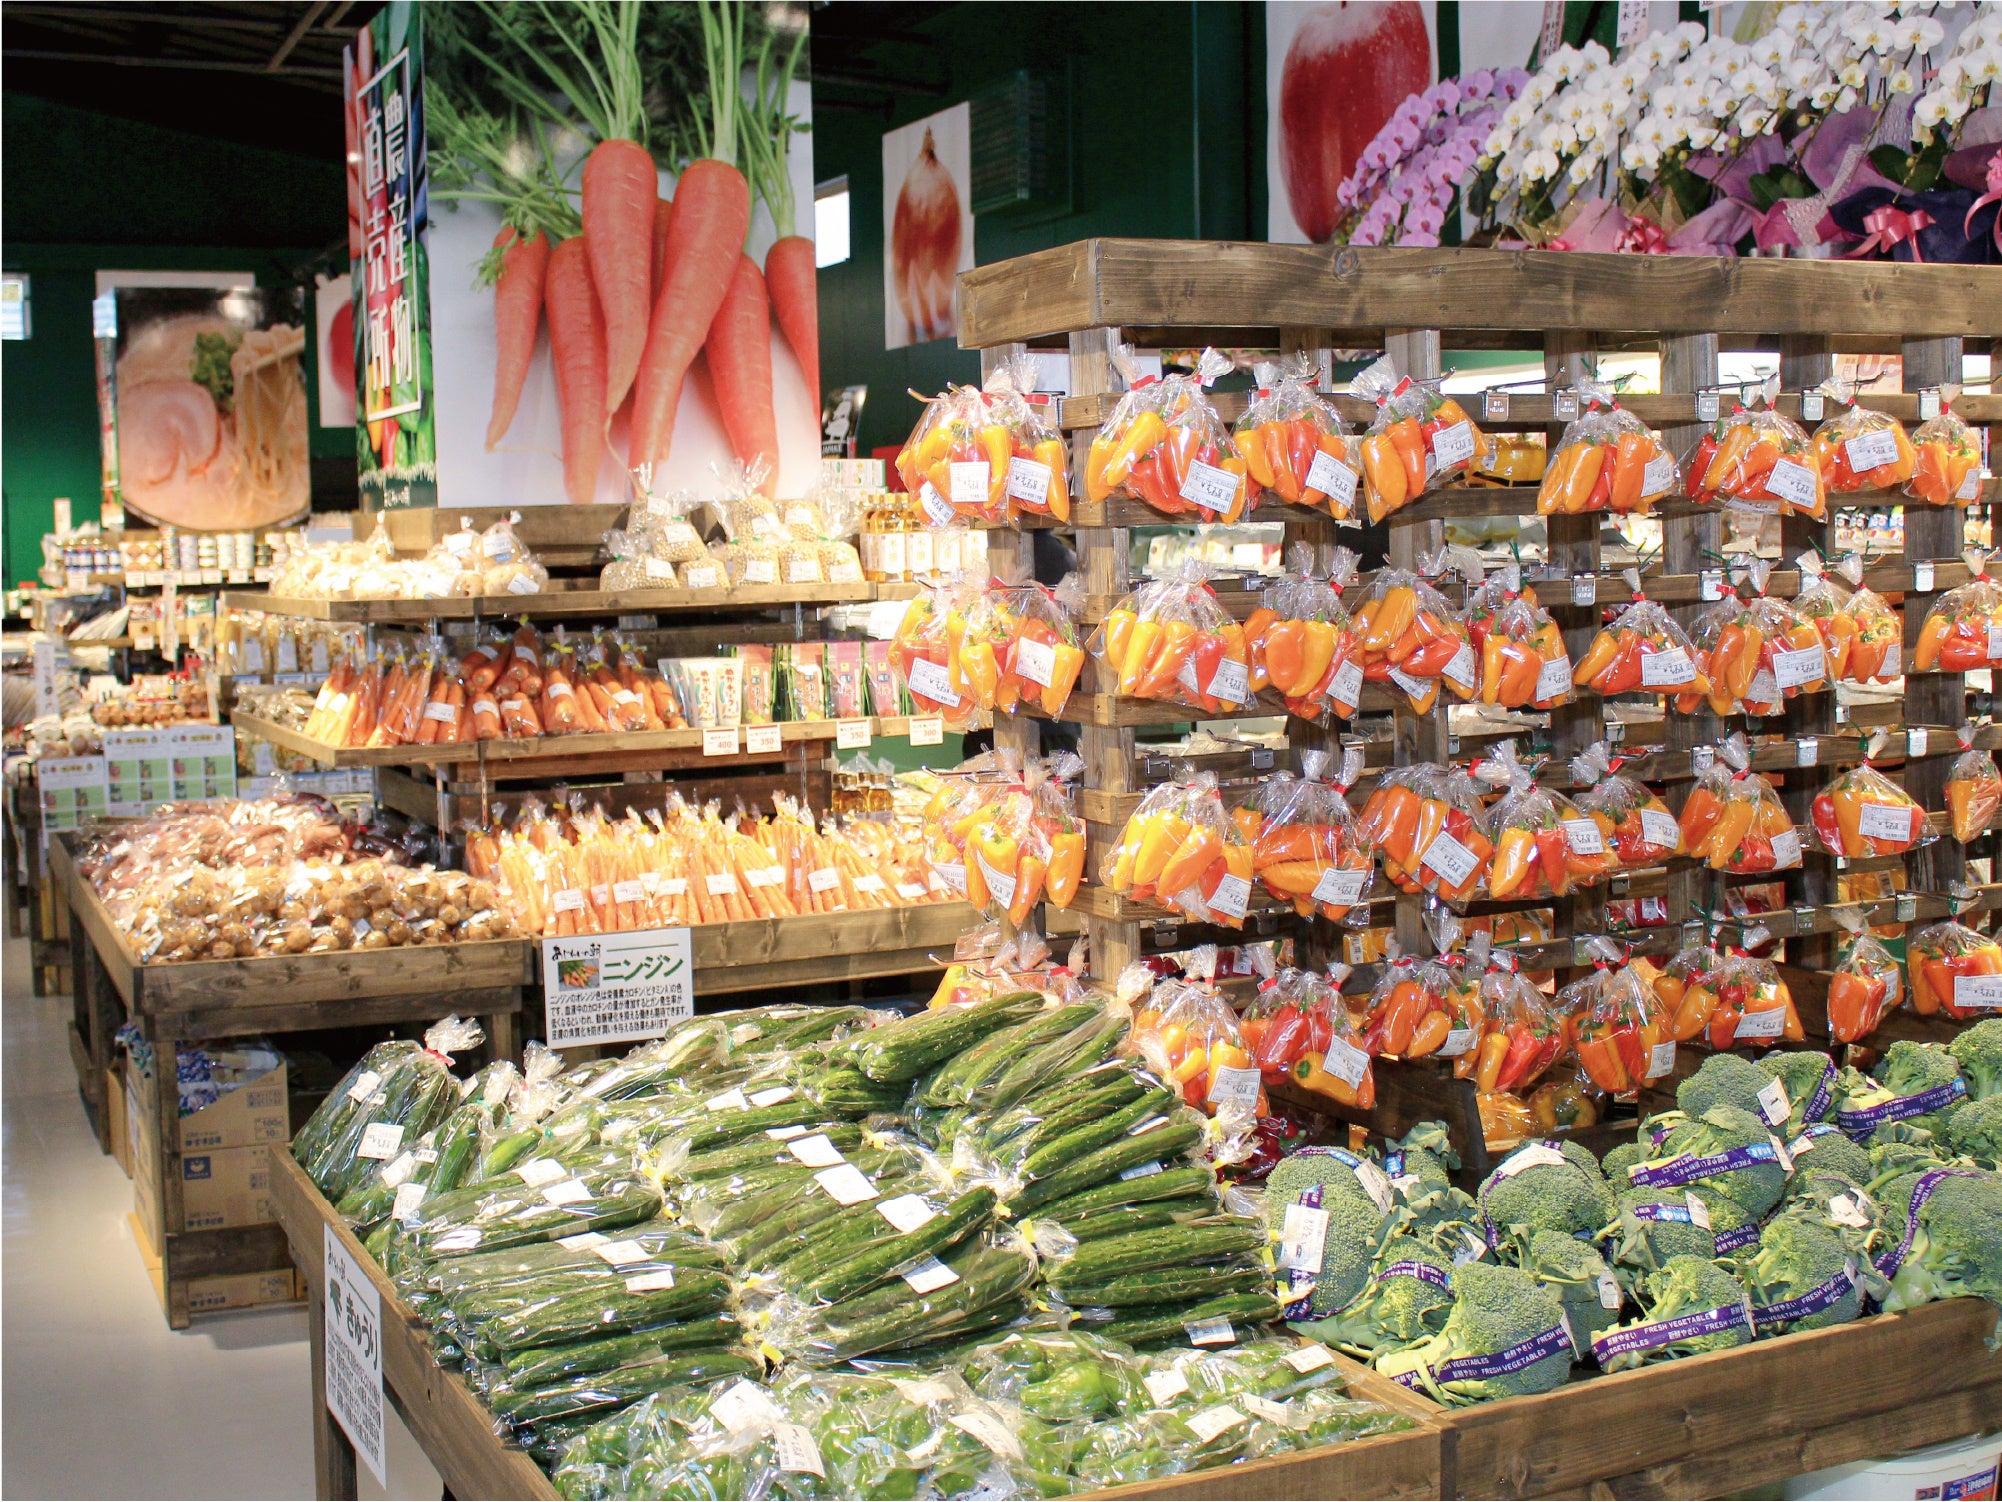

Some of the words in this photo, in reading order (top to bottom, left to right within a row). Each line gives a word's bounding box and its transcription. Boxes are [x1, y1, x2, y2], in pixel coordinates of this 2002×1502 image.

[364, 106, 391, 391] 直売所
[384, 88, 412, 385] 農産物
[602, 954, 684, 981] ニンジン
[1687, 1165, 1729, 1181] VEGETABLES
[1729, 1158, 1752, 1169] FRESH
[1801, 1288, 1822, 1304] FRESH
[346, 1291, 379, 1371] きゅうり
[1643, 1323, 1668, 1335] FRESH
[1668, 1313, 1712, 1328] VEGETABLE
[1704, 1319, 1728, 1331] FRESH
[1452, 1357, 1490, 1369] VEGETABLES
[1536, 1332, 1556, 1346] FRESH
[1481, 1367, 1501, 1378] FRESH
[1501, 1348, 1547, 1373] VEGETABLES
